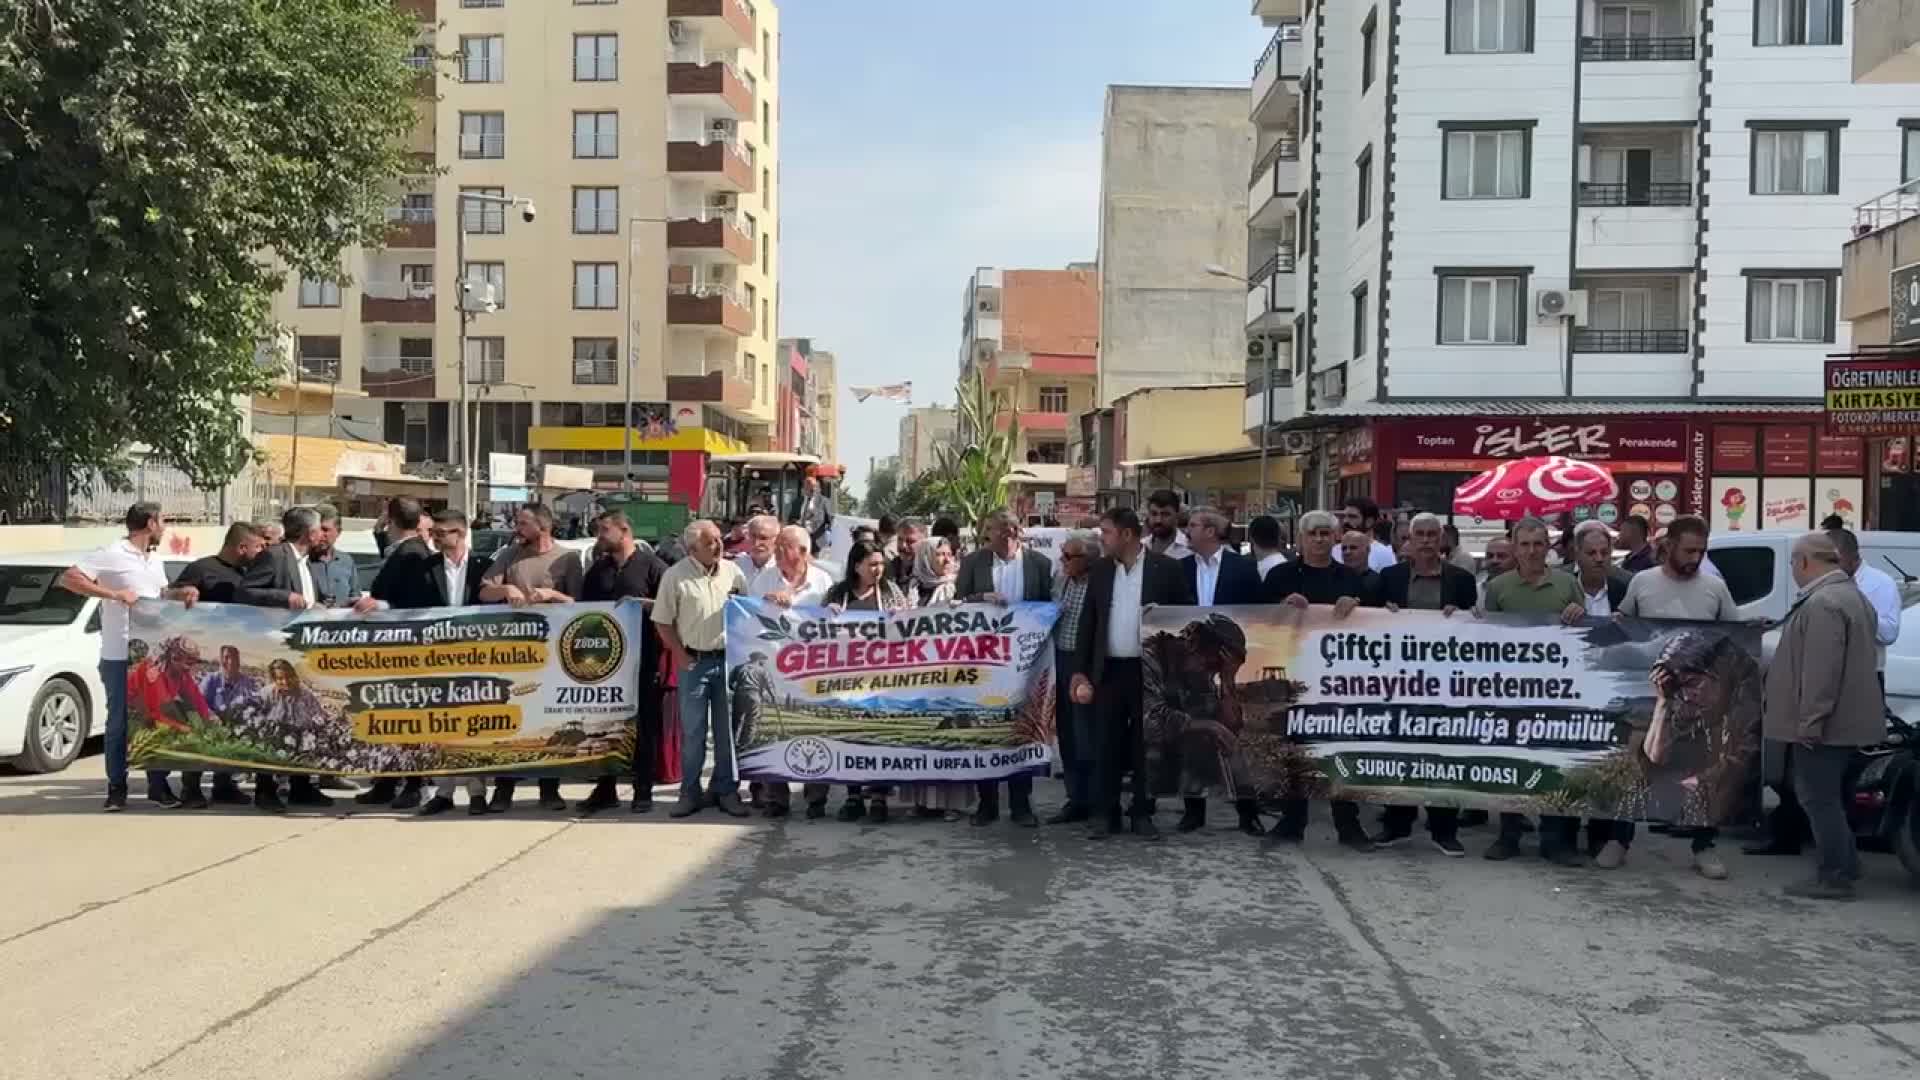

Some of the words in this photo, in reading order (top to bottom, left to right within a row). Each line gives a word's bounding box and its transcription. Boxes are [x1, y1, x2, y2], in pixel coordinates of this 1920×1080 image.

[1416, 435, 1455, 447] Toptan
[1619, 437, 1678, 449] Perakende
[301, 626, 369, 645] Mazota
[373, 628, 418, 644] zam,
[422, 621, 499, 646] gübreye
[798, 617, 886, 642] ÇİFTÇİ
[895, 611, 990, 638] VARSA
[318, 651, 419, 670] destekleme
[425, 647, 487, 667] devede
[490, 645, 544, 665] kulak.
[776, 640, 928, 673] GELECEK
[934, 634, 1012, 660] VAR!
[1320, 632, 1392, 668] Çiftçi
[1400, 635, 1569, 668] üretemezse,
[360, 680, 442, 708] Çiftçiye
[447, 680, 501, 703] kaldı
[815, 677, 865, 694] EMEK
[869, 667, 949, 688] ALINTERİ
[954, 667, 979, 685] AŞ
[1320, 669, 1441, 702] sanayide
[1450, 670, 1581, 700] üretemez.
[367, 712, 422, 736] kuru
[429, 711, 461, 733] bir
[466, 713, 517, 737] gam.
[1287, 708, 1393, 736] Memleket
[1399, 709, 1509, 744] karanlığa
[1516, 712, 1618, 745] gömülür.
[845, 756, 877, 770] DEM
[882, 754, 928, 770] PARTİ
[933, 757, 972, 769] URFA
[975, 755, 987, 769] İL
[1356, 758, 1407, 783] SURUÇ
[1410, 758, 1464, 781] ZİRAAT
[1470, 766, 1518, 784] ODASI
